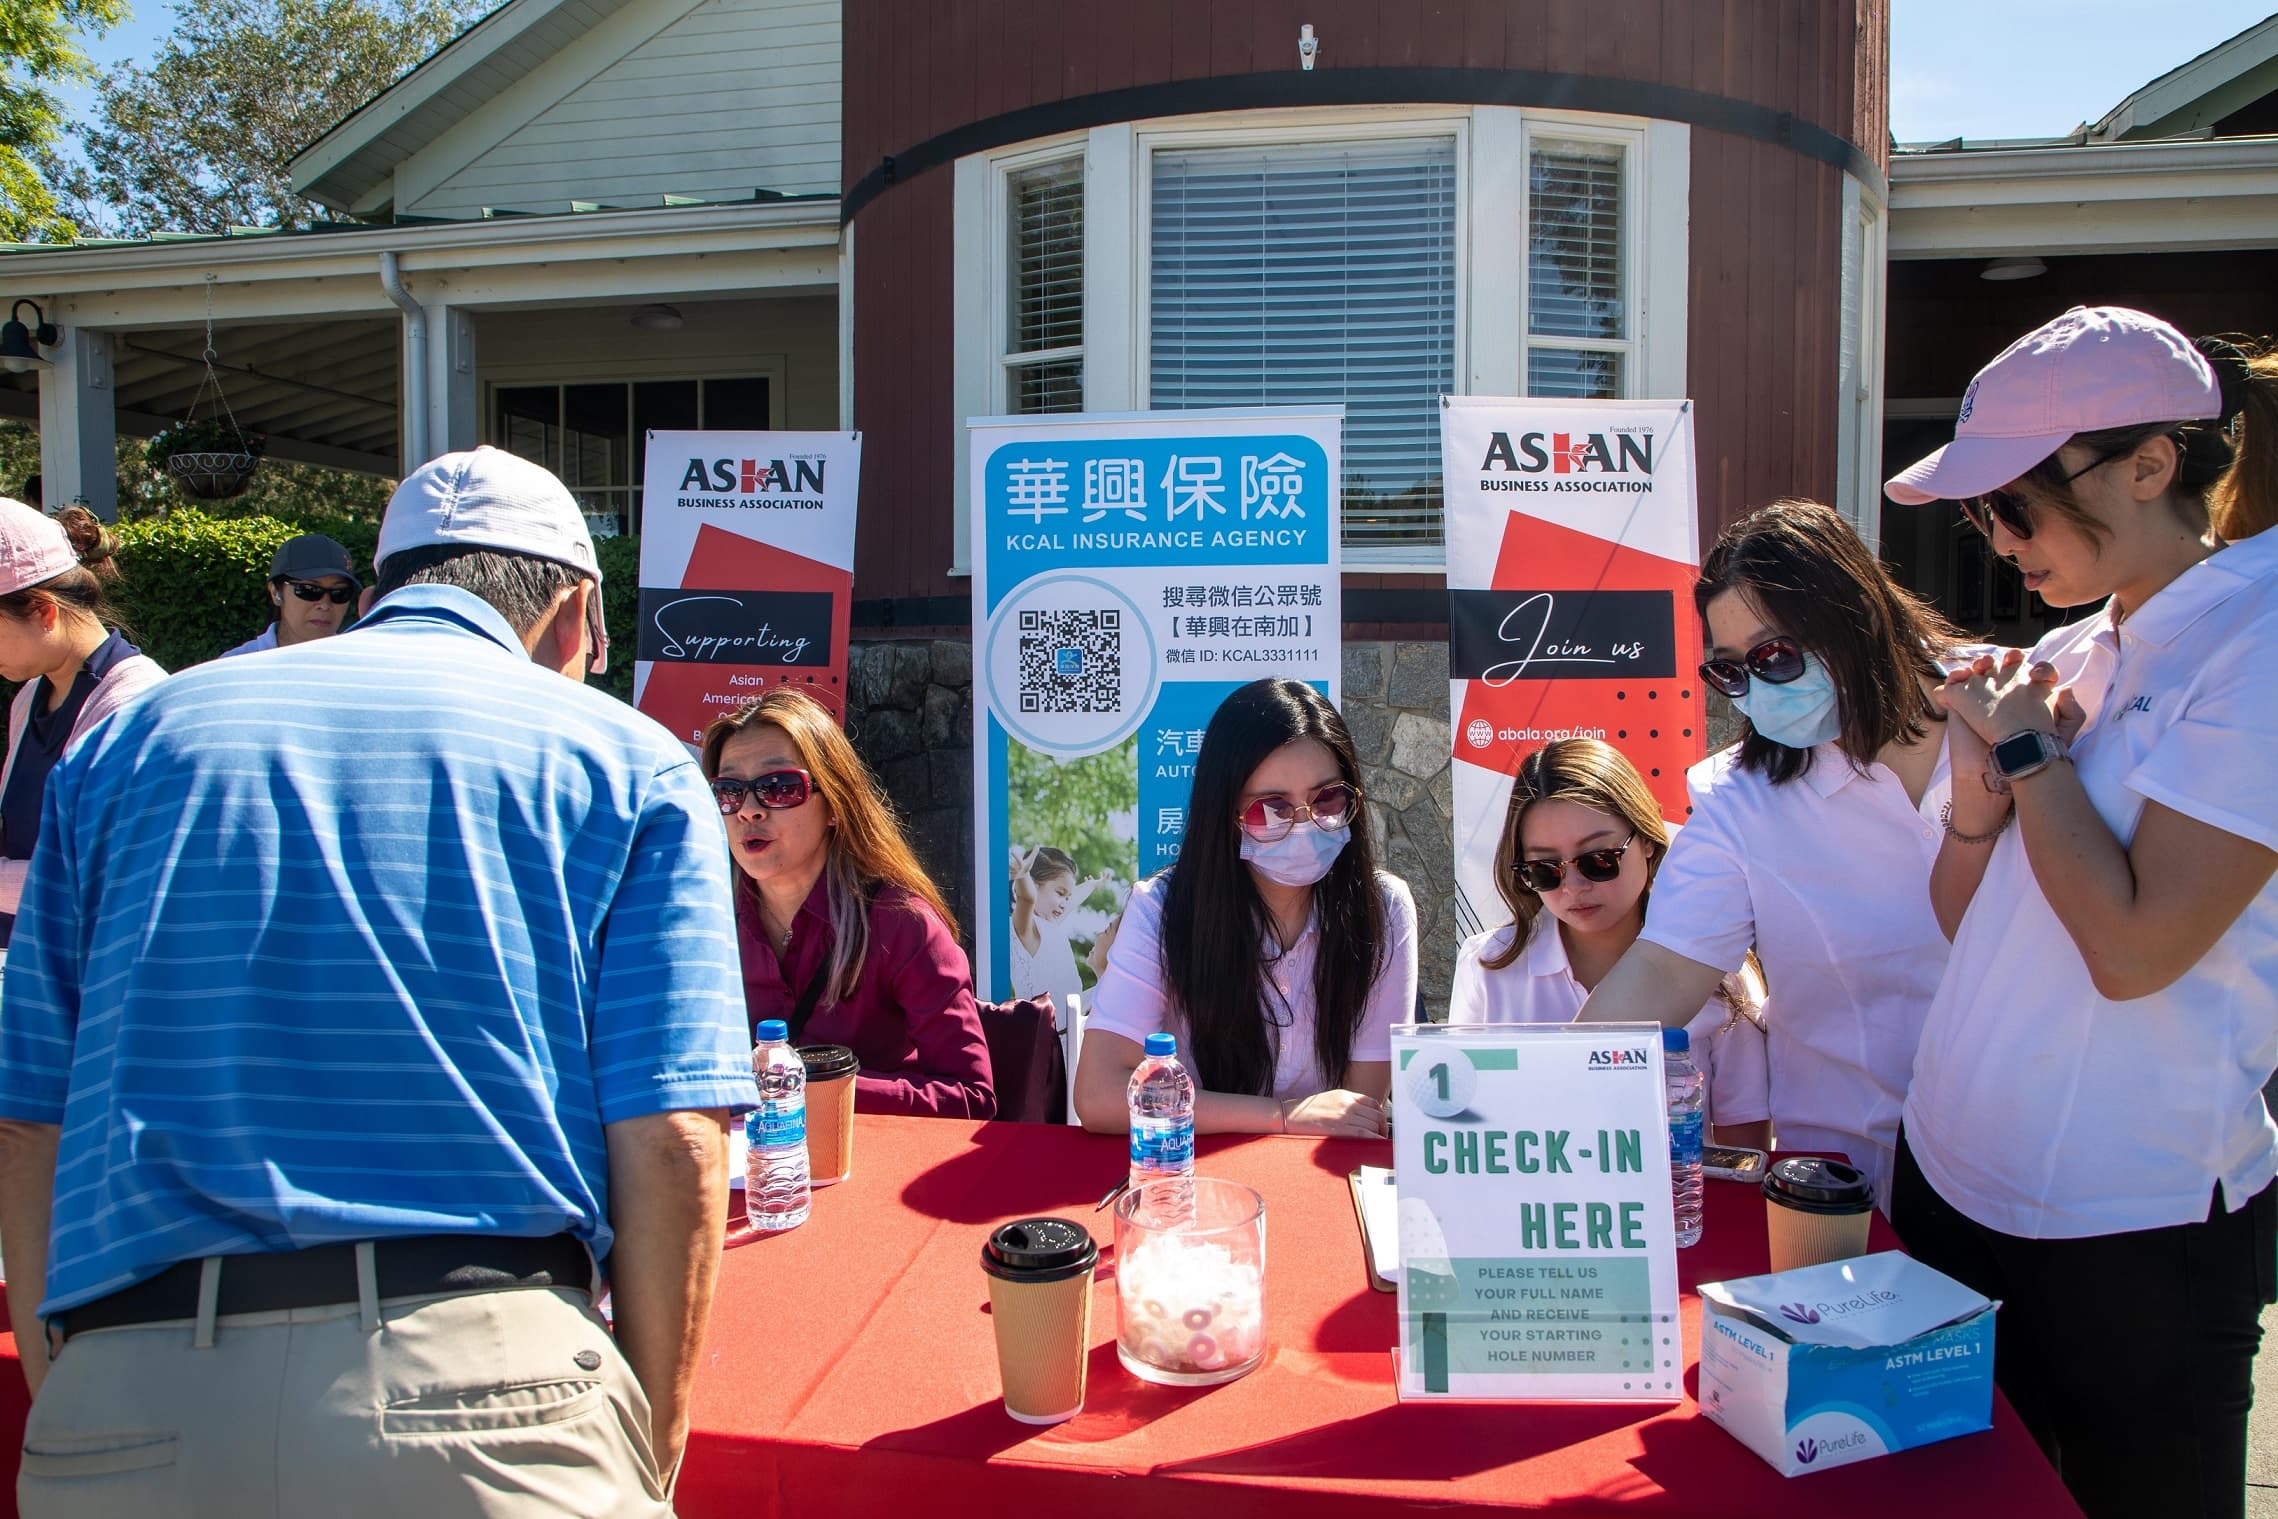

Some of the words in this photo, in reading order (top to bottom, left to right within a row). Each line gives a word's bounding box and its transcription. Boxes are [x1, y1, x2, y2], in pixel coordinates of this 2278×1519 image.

[1480, 431, 1654, 475] ASIAN
[679, 458, 826, 495] ASIAN
[1480, 479, 1549, 492] BUSINESS
[1553, 481, 1653, 493] ASSOCIATION
[1006, 451, 1306, 525] 華興保險
[677, 498, 736, 509] BUSINESS
[739, 499, 824, 510] ASSOCIATION
[1006, 533, 1065, 551] KCAL
[1072, 531, 1204, 550] INSURANCE
[1211, 529, 1307, 547] AGENCY
[654, 596, 811, 663] Supporting
[1482, 592, 1617, 688] Join
[1611, 641, 1646, 660] us
[1166, 648, 1196, 664] 微信
[1199, 650, 1218, 662] ID:
[1222, 649, 1319, 662] KCAL3331111
[729, 674, 764, 686] Asian
[1498, 725, 1606, 740] abala.org/join
[1157, 807, 1183, 835] 房
[1156, 843, 1181, 856] HO
[1588, 1050, 1647, 1065] ASIAN
[1429, 1062, 1450, 1101] 1
[1423, 1129, 1643, 1174] CHECK-IN
[1520, 1202, 1646, 1249] HERE
[1478, 1268, 1534, 1279] PLEASE
[1538, 1268, 1574, 1279] TELL
[1577, 1267, 1598, 1278] US
[1475, 1288, 1517, 1300] YOUR
[1521, 1288, 1556, 1299] FULL
[1560, 1288, 1604, 1299] NAME
[1816, 1290, 1897, 1316] PureLife
[1490, 1309, 1523, 1321] AND
[1526, 1309, 1590, 1320] RECEIVE
[1480, 1330, 1522, 1341] YOUR
[1526, 1329, 1602, 1341] STARTING
[1713, 1321, 1737, 1342] ASTM
[1737, 1335, 1767, 1359] LEVEL
[1488, 1351, 1527, 1362] HOLE
[1532, 1350, 1596, 1362] NUMBER
[1885, 1352, 1923, 1371] ASTM
[1927, 1345, 1971, 1362] LEVEL
[1975, 1343, 1981, 1354] 1
